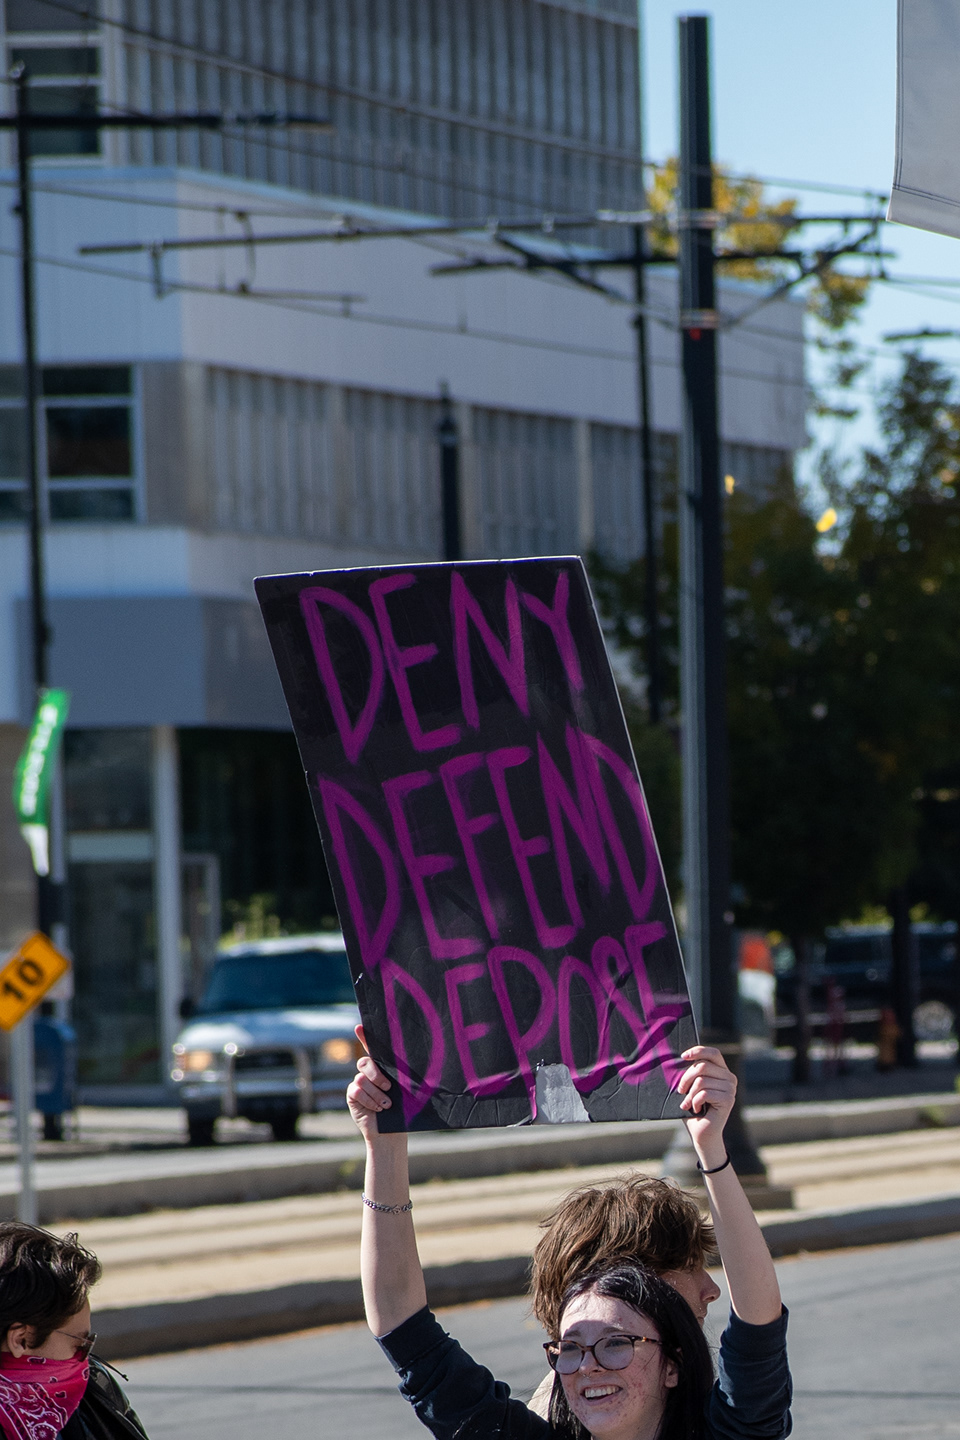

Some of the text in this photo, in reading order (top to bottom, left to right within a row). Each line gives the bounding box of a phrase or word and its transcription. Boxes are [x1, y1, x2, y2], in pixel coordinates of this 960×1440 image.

[299, 568, 584, 765] DENY
[318, 720, 659, 978] DEFEND
[380, 920, 692, 1127] DEPOSE
